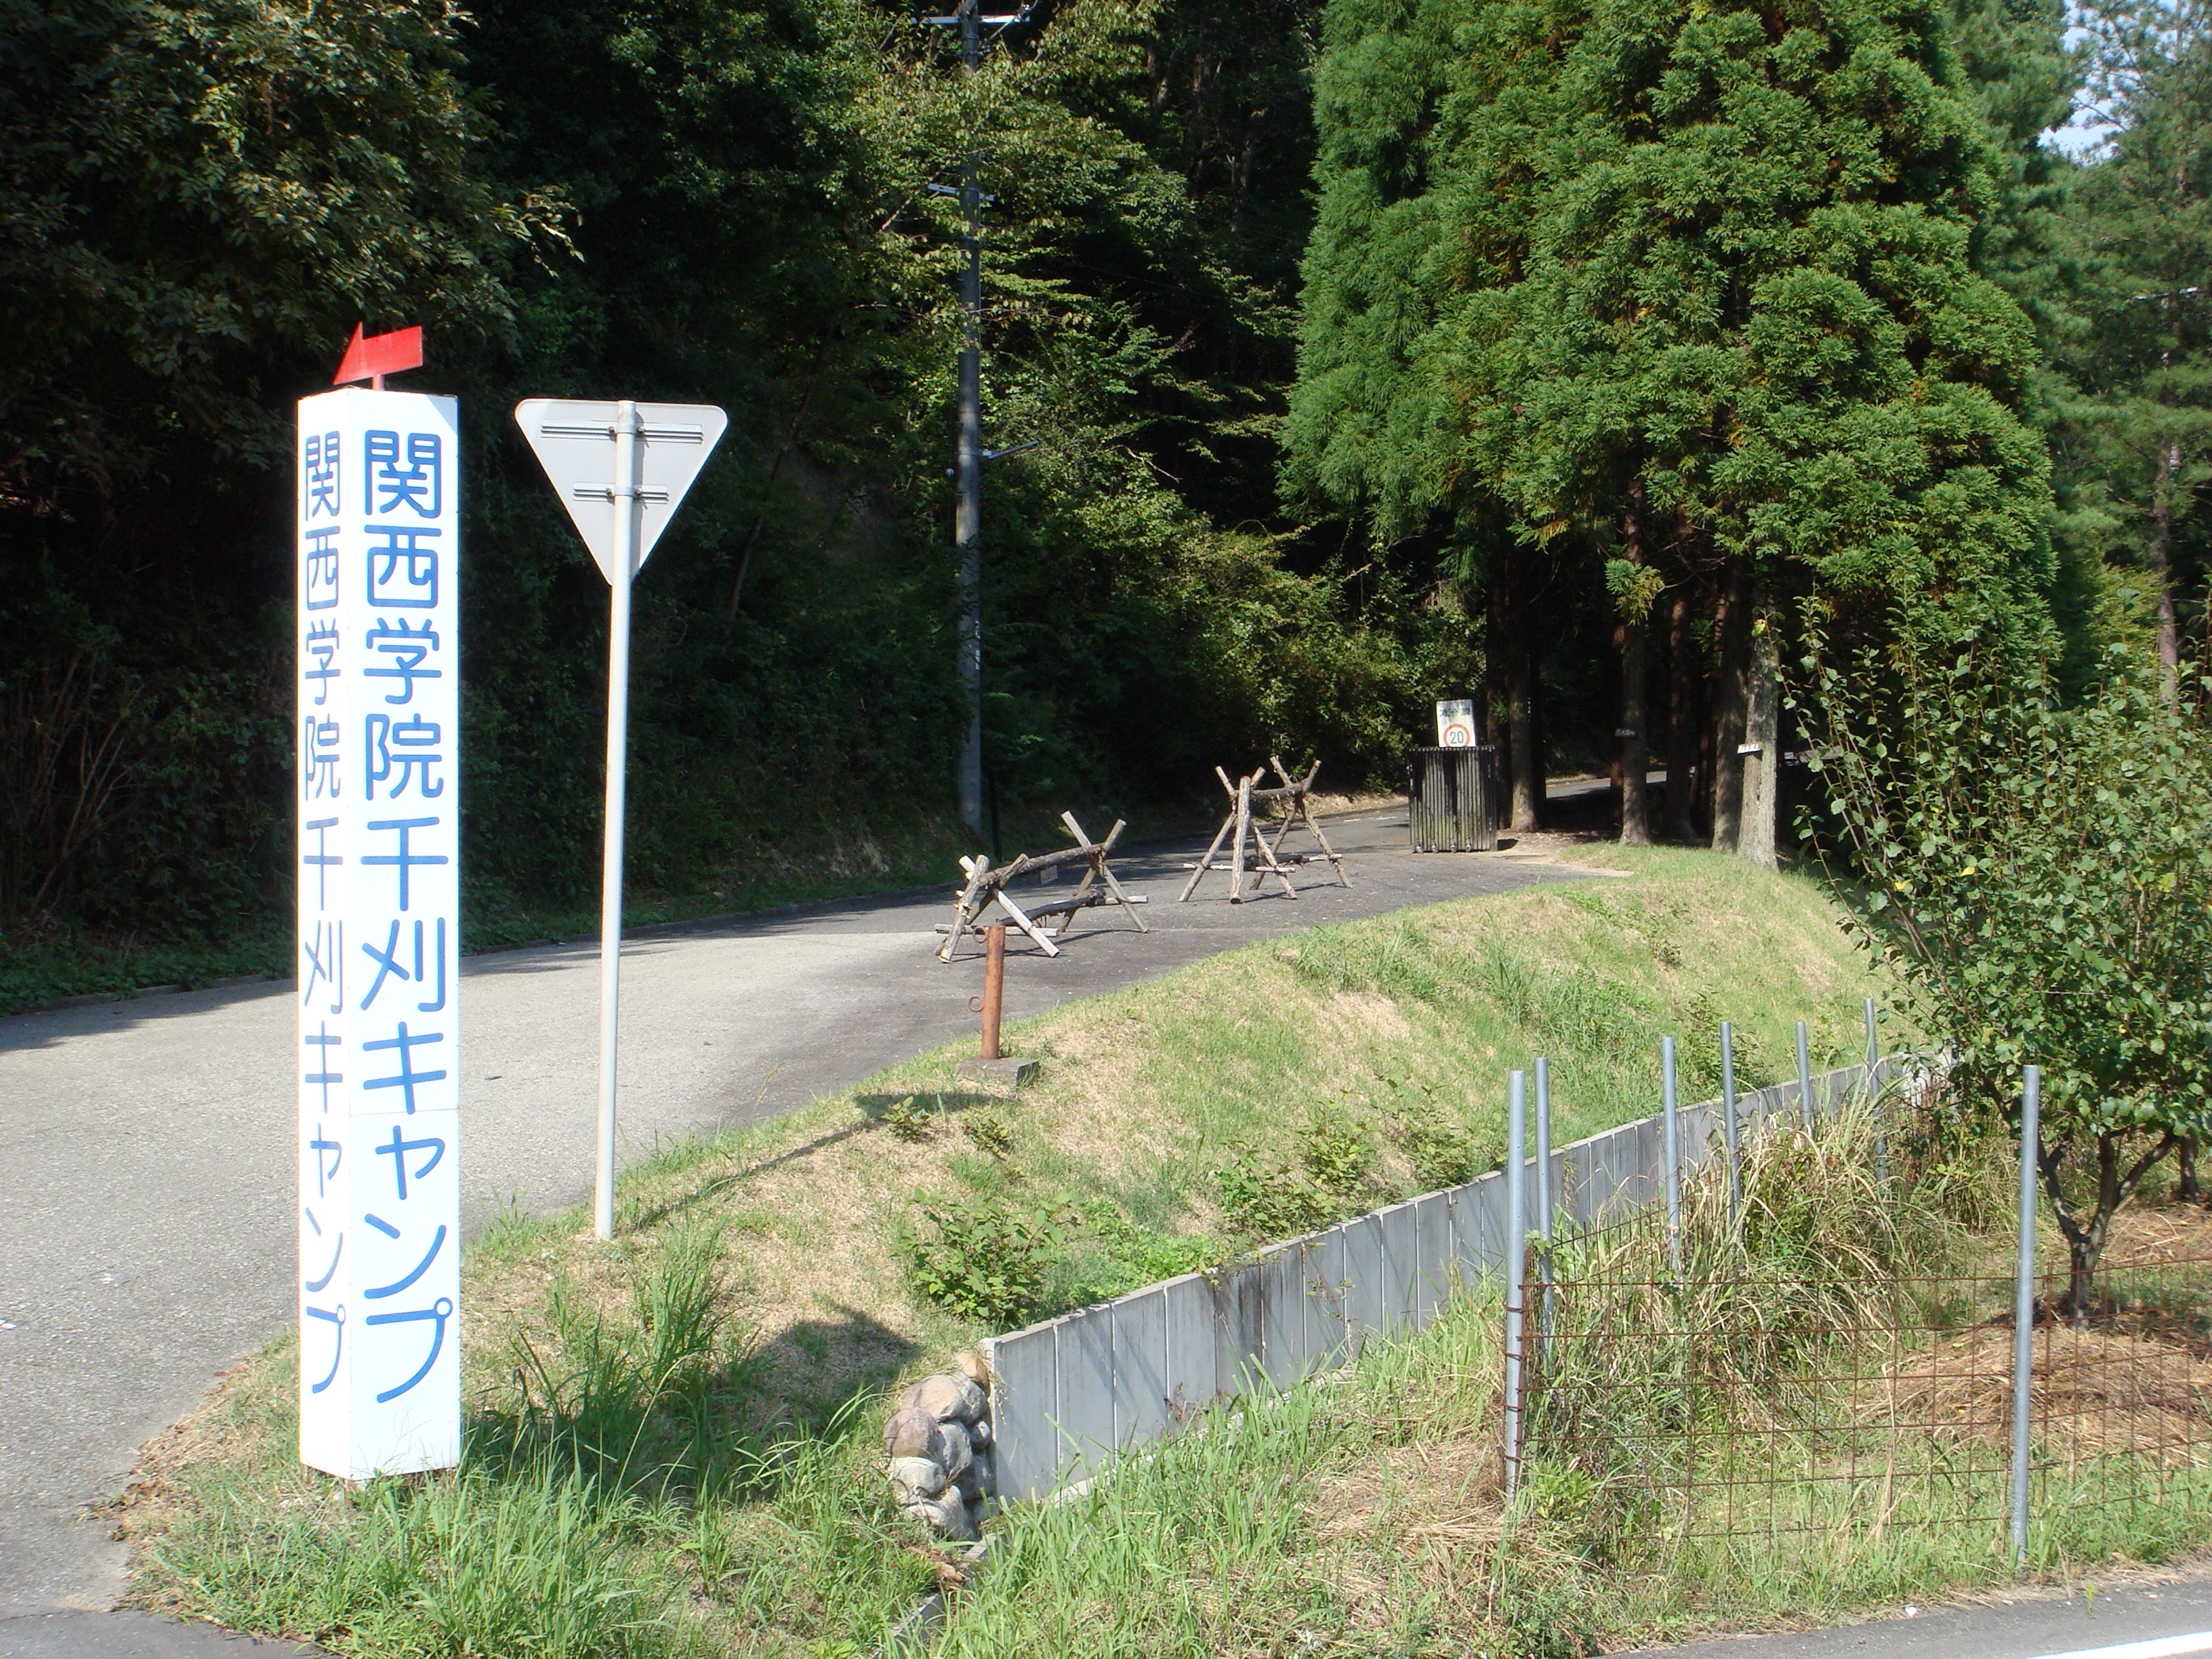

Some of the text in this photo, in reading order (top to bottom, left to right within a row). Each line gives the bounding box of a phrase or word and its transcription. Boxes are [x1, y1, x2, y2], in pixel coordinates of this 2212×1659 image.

[303, 429, 344, 1395] 関西学院千刈キャンプ
[362, 428, 452, 1404] 関西学院千刈キャンプ
[1450, 731, 1464, 744] 20
